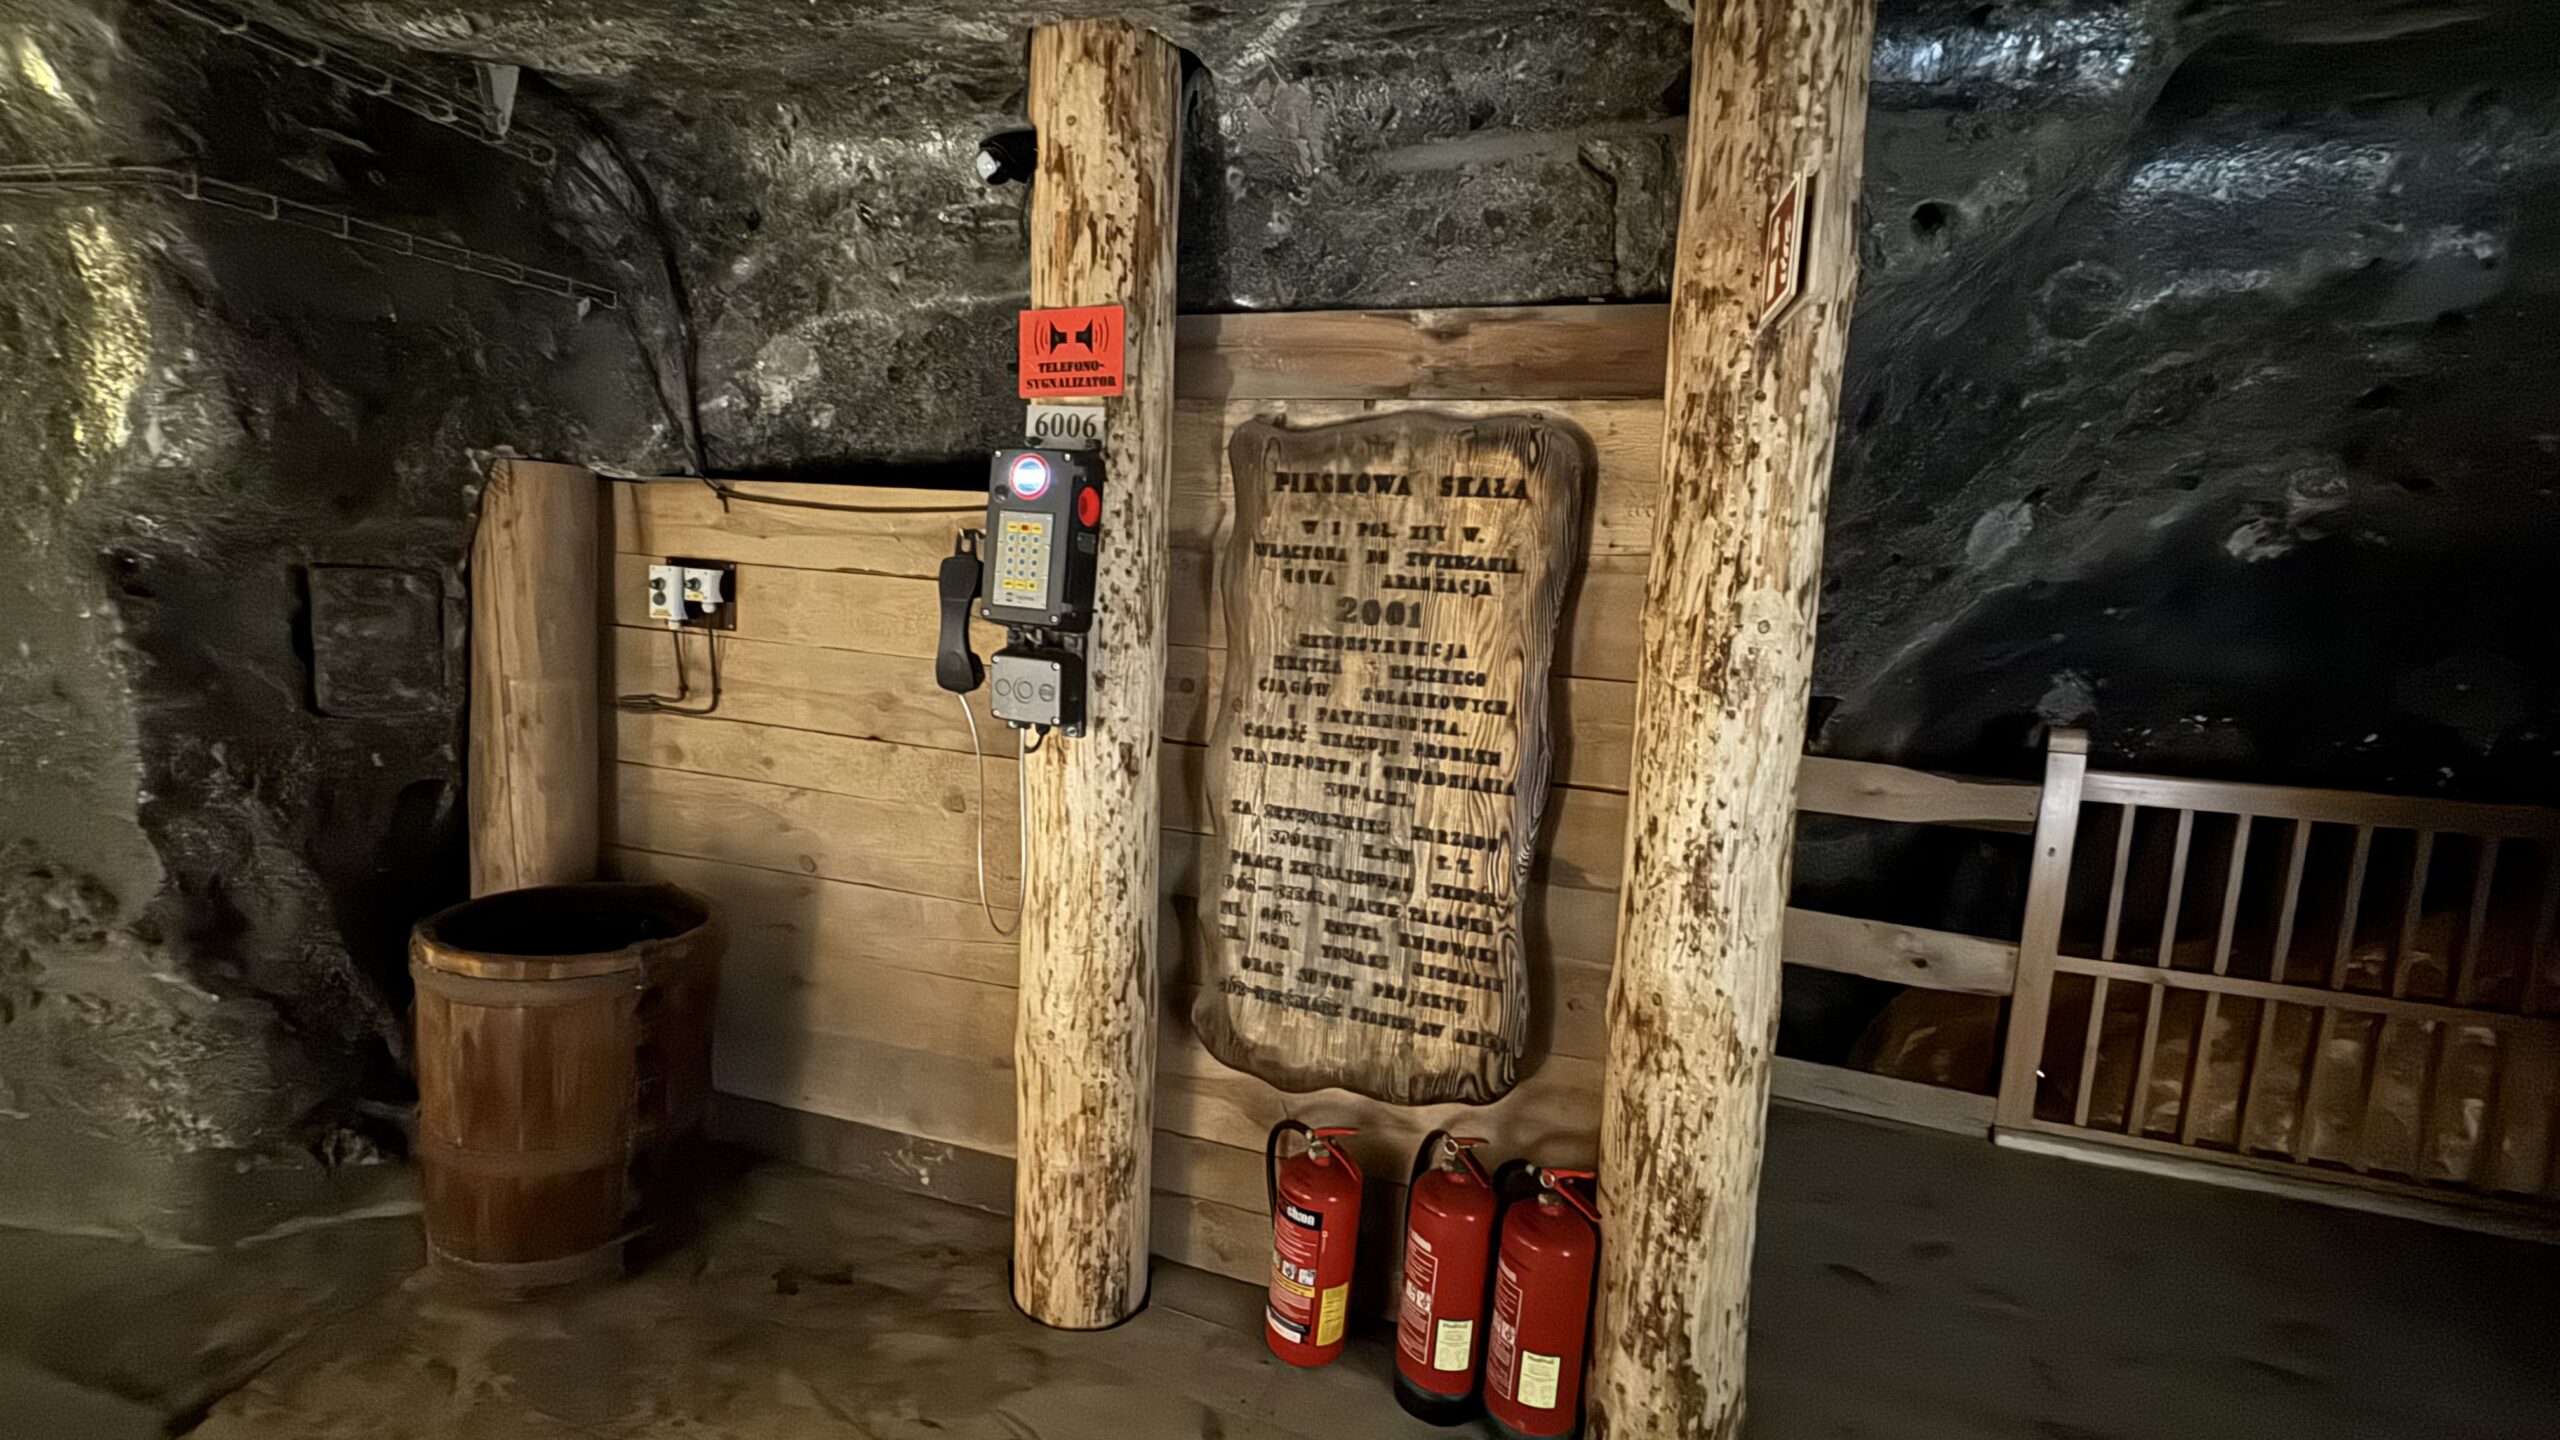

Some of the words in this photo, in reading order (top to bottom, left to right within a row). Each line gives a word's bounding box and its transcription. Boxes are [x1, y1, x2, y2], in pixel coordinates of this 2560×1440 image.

[1038, 360, 1105, 374] TELEFONO-
[1026, 375, 1117, 390] SYGNALIZATOR
[1034, 412, 1098, 438] 6006
[1272, 471, 1412, 497] PIESKOWA
[1440, 475, 1529, 499] SKAŁA
[1301, 520, 1319, 535] W
[1332, 520, 1342, 536] I
[1462, 527, 1485, 543] W.
[1366, 549, 1389, 564] DO
[1335, 596, 1421, 628] 2001
[1299, 633, 1468, 662] REKONSTRUKCJA
[1258, 676, 1330, 698] CIĄGÓW
[1362, 687, 1509, 716] SOLANKOWYCH
[1288, 704, 1296, 719] I
[1413, 741, 1501, 767] PROBLEM
[1231, 746, 1351, 775] TRANSPORTU
[1359, 761, 1368, 778] I
[1383, 765, 1516, 796] ODWADNIANIA
[1231, 849, 1283, 872] PRACE
[1241, 956, 1285, 976] ORAZ
[1297, 967, 1355, 990] AUTOR
[1373, 982, 1468, 1014] PROJEKTU
